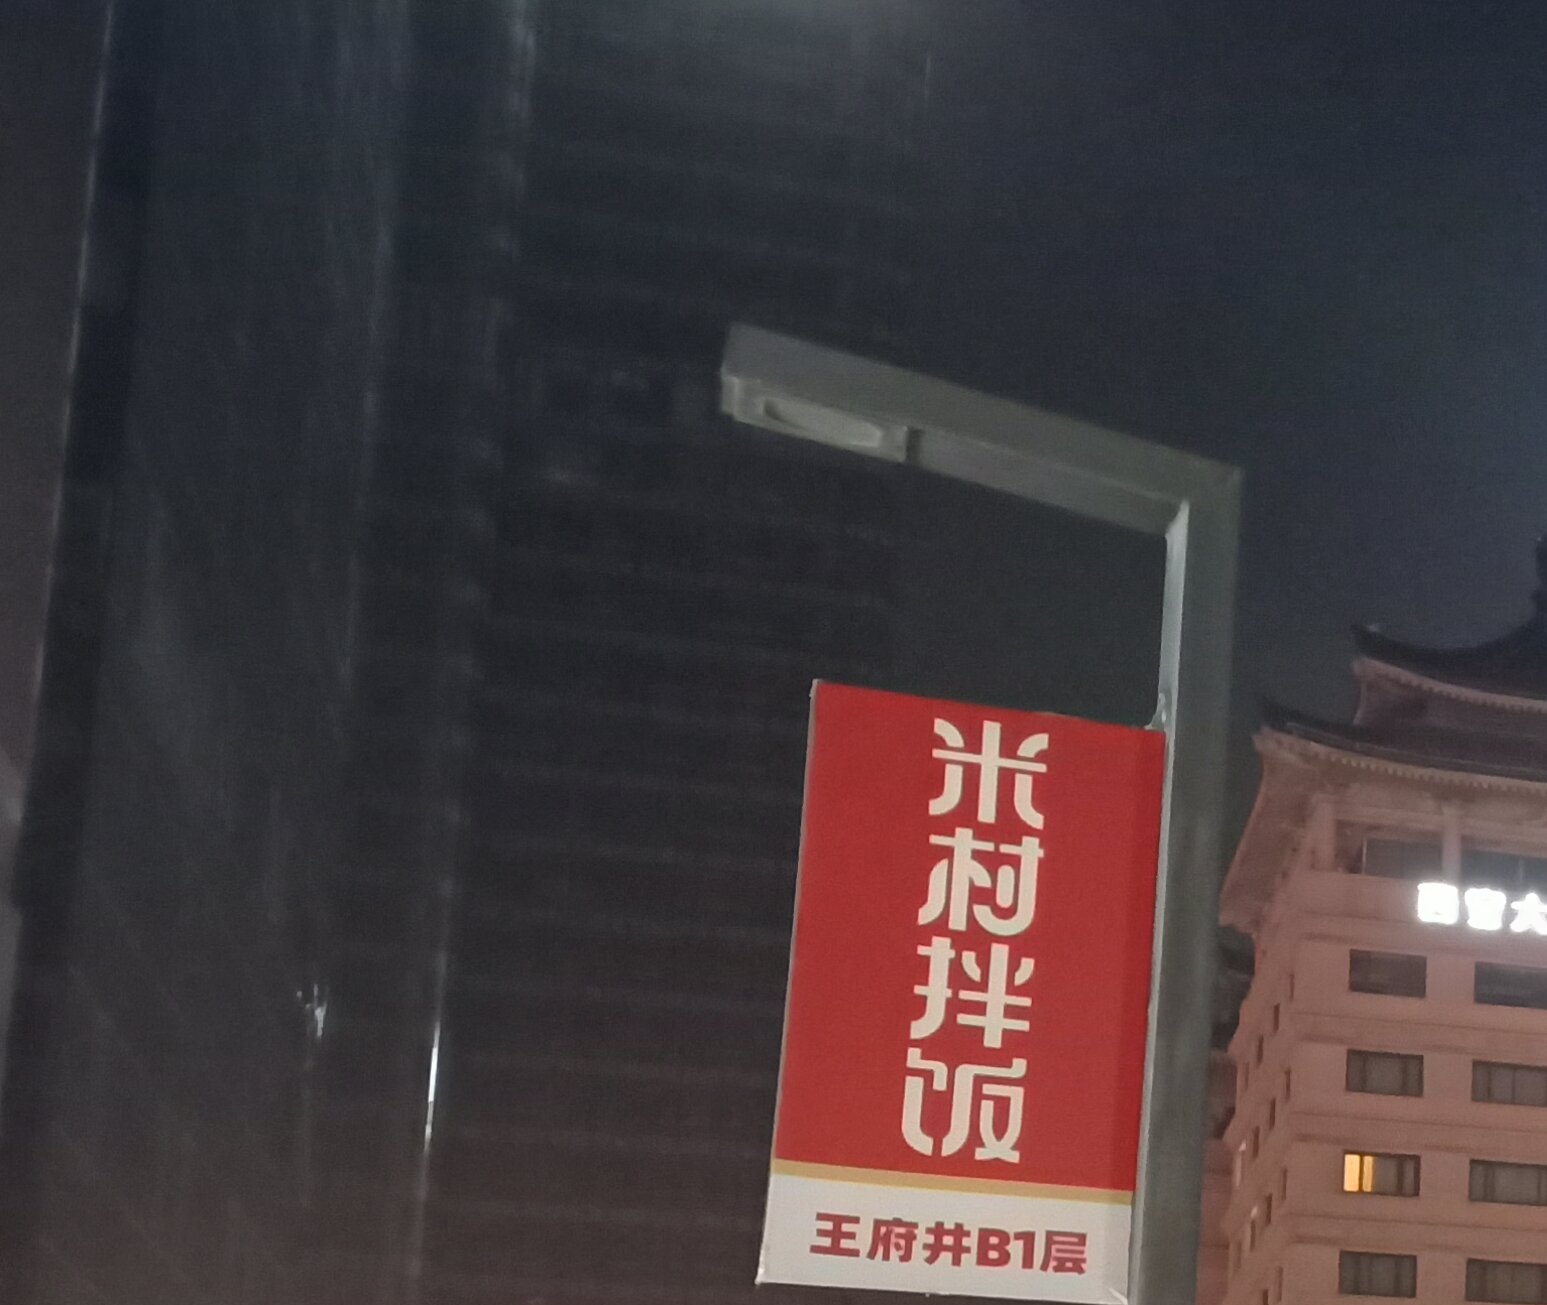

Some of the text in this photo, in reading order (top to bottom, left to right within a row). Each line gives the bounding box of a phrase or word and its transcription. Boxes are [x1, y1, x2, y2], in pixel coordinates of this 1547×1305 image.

[901, 719, 1049, 1164] 米村拌饭
[810, 1211, 1088, 1275] 王府井B1层
